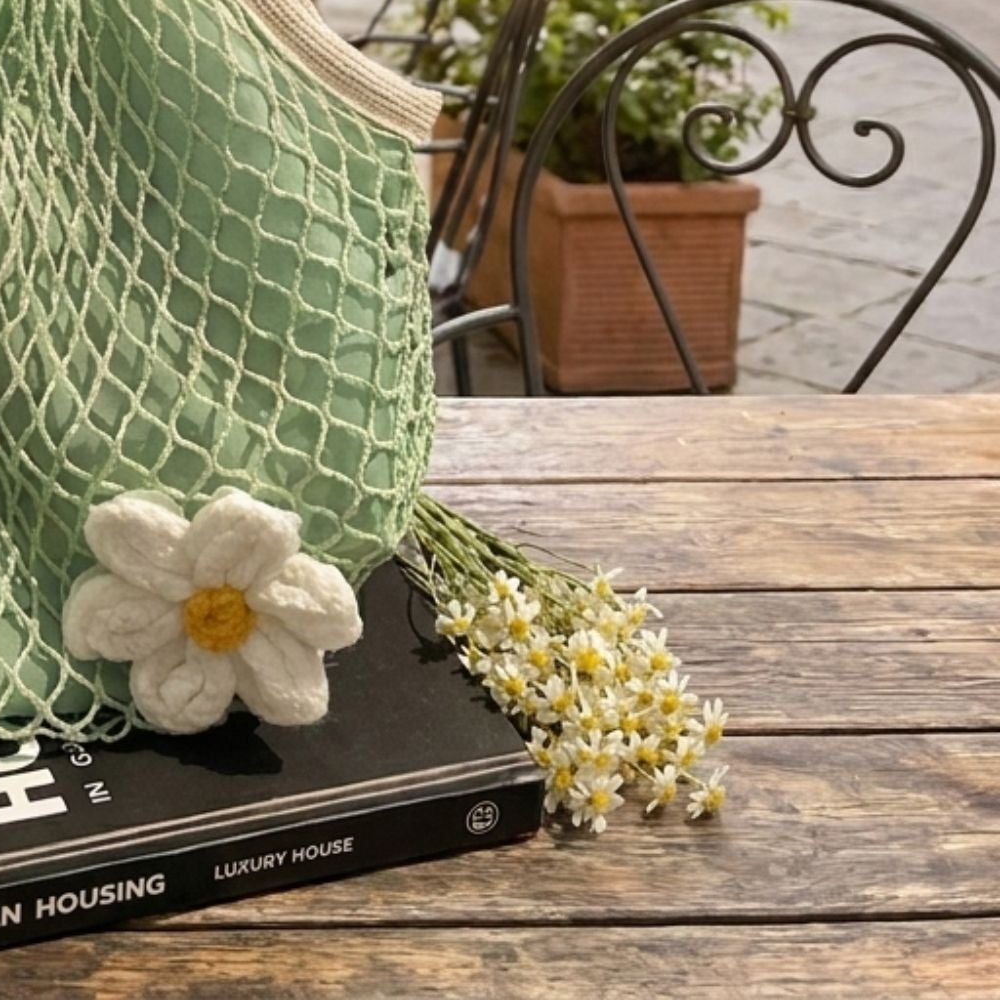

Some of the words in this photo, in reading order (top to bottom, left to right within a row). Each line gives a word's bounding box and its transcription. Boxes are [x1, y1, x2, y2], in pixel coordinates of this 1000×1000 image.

[83, 780, 112, 804] IN
[213, 850, 288, 880] LUXURY
[291, 836, 355, 863] HOUSE
[34, 872, 166, 920] HOUSING
